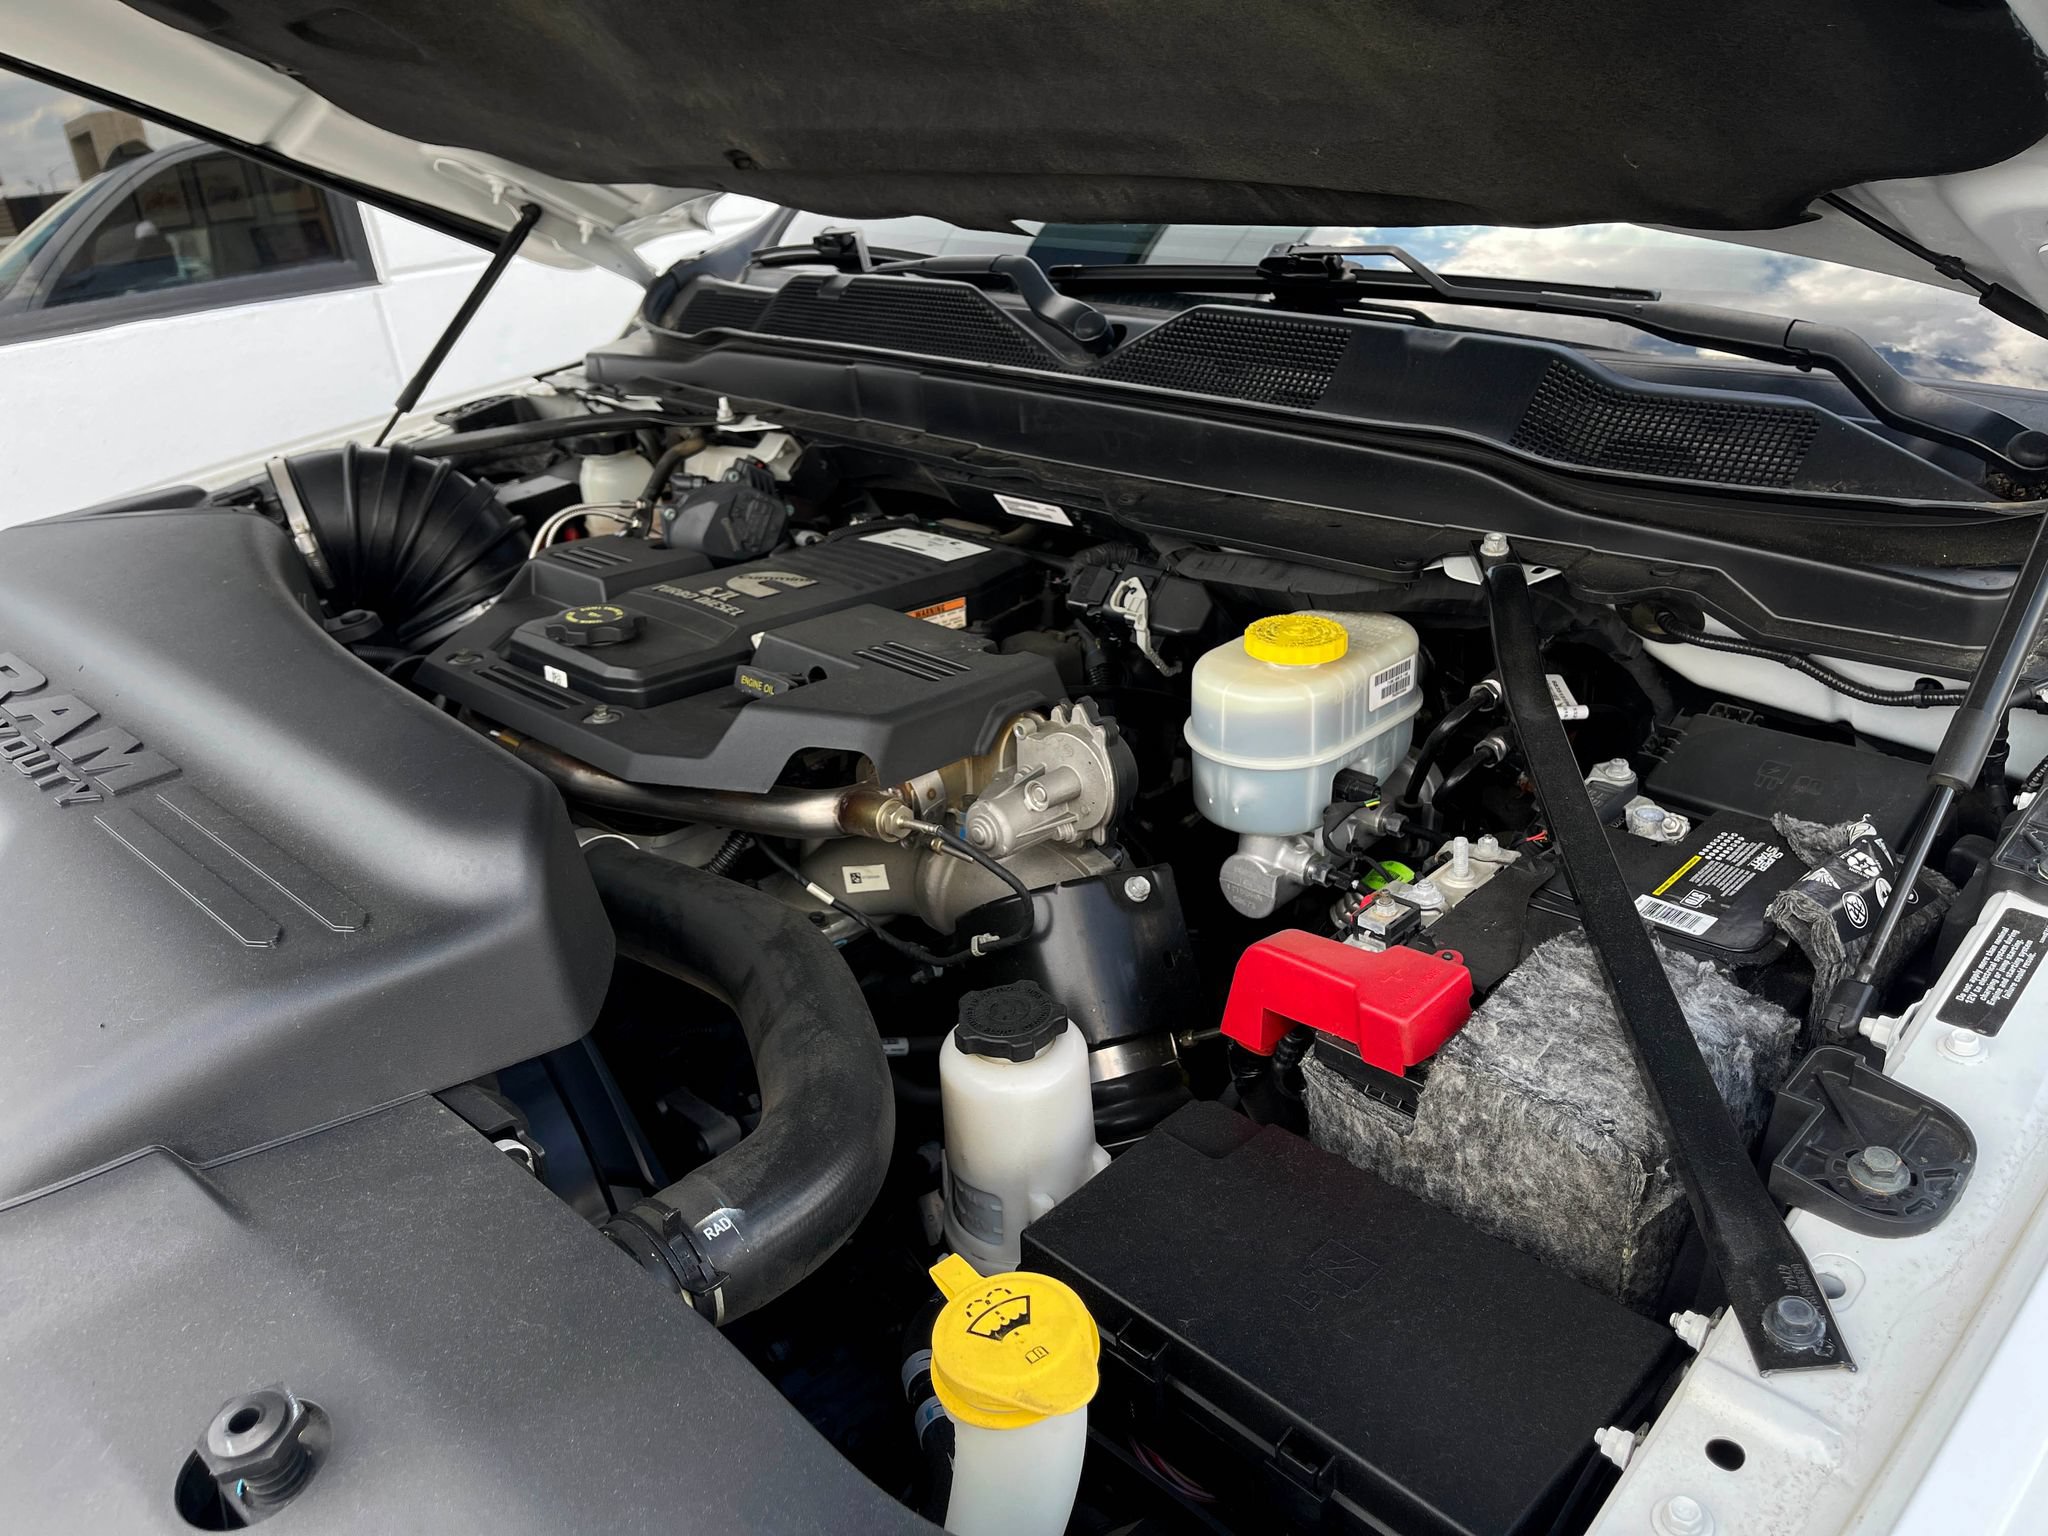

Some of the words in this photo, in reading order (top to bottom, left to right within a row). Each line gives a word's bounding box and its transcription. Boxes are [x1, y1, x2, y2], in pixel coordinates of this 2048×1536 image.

[652, 584, 698, 600] TURBO
[693, 596, 745, 617] DIESEL
[741, 674, 763, 691] ENGINE
[763, 683, 775, 695] OIL
[1749, 845, 1775, 870] START
[1758, 850, 1784, 872] SUPER
[702, 1217, 732, 1241] RAD
